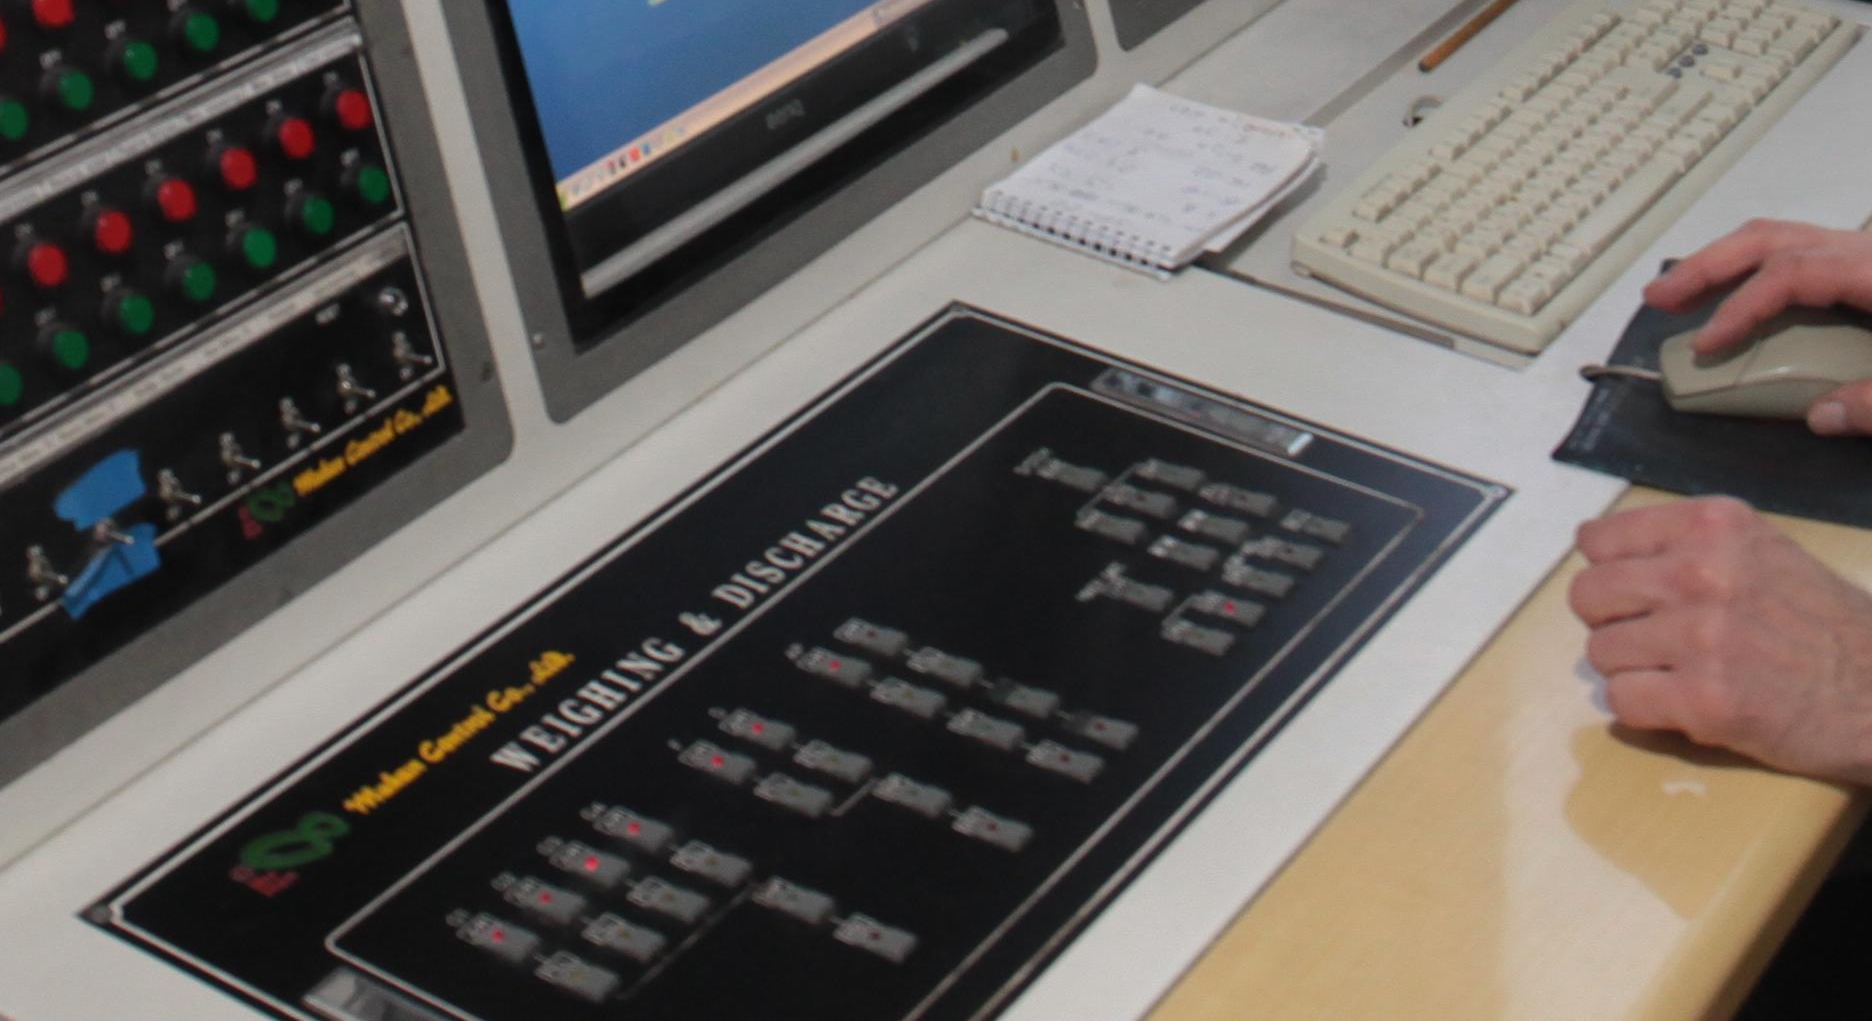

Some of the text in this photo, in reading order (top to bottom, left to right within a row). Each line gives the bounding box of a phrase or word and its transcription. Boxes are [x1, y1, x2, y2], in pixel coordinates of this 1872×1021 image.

[489, 475, 899, 773] WEIGHING & DISCHARGE
